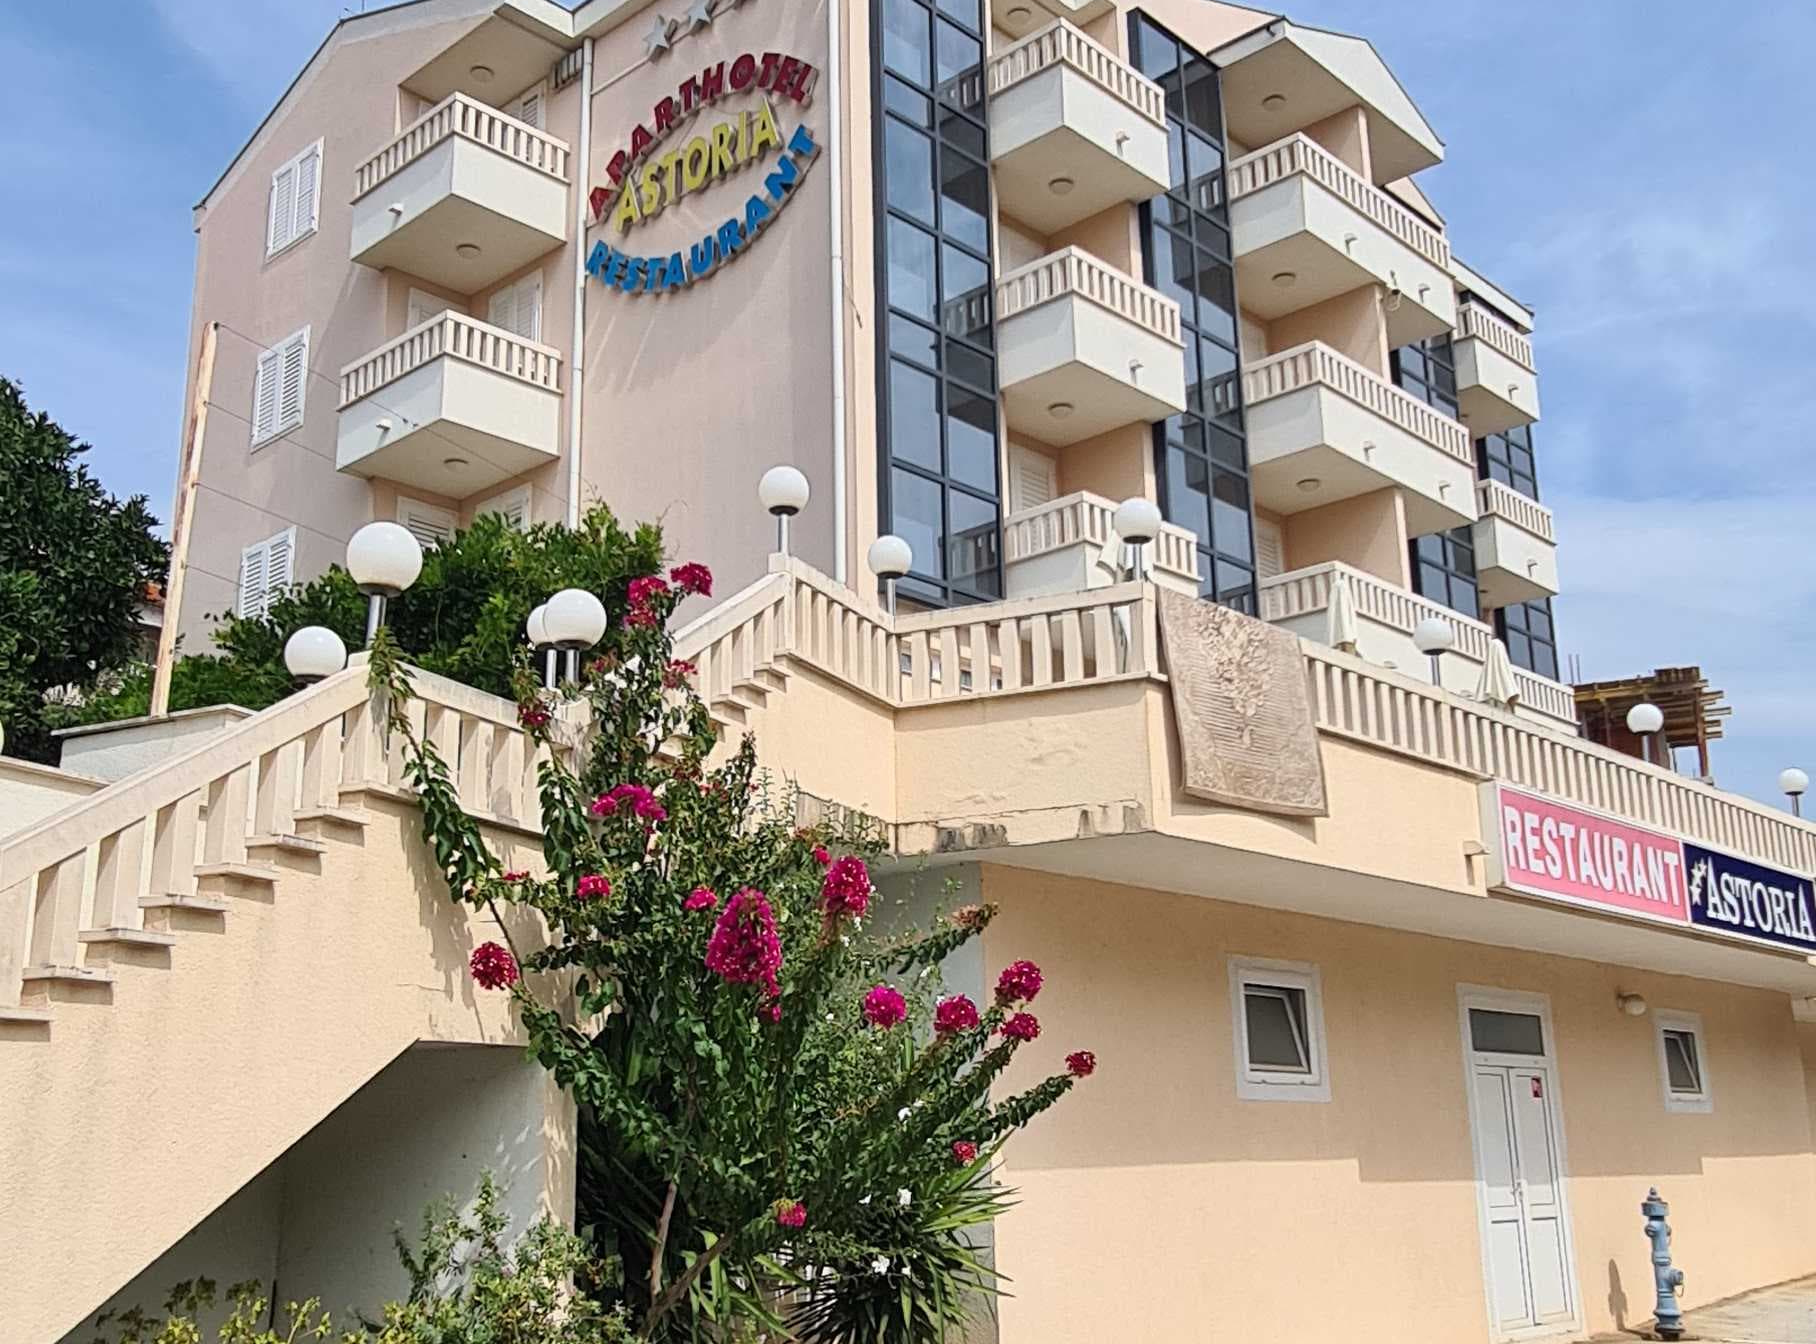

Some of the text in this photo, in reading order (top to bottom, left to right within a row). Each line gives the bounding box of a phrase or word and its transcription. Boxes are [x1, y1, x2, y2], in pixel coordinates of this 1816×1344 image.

[589, 52, 814, 219] APARTHOTEL
[614, 96, 780, 233] ASTORIA
[586, 123, 814, 292] RESTAURANT
[1503, 805, 1679, 905] RESTAURANT
[1706, 856, 1815, 941] ASTORIA
